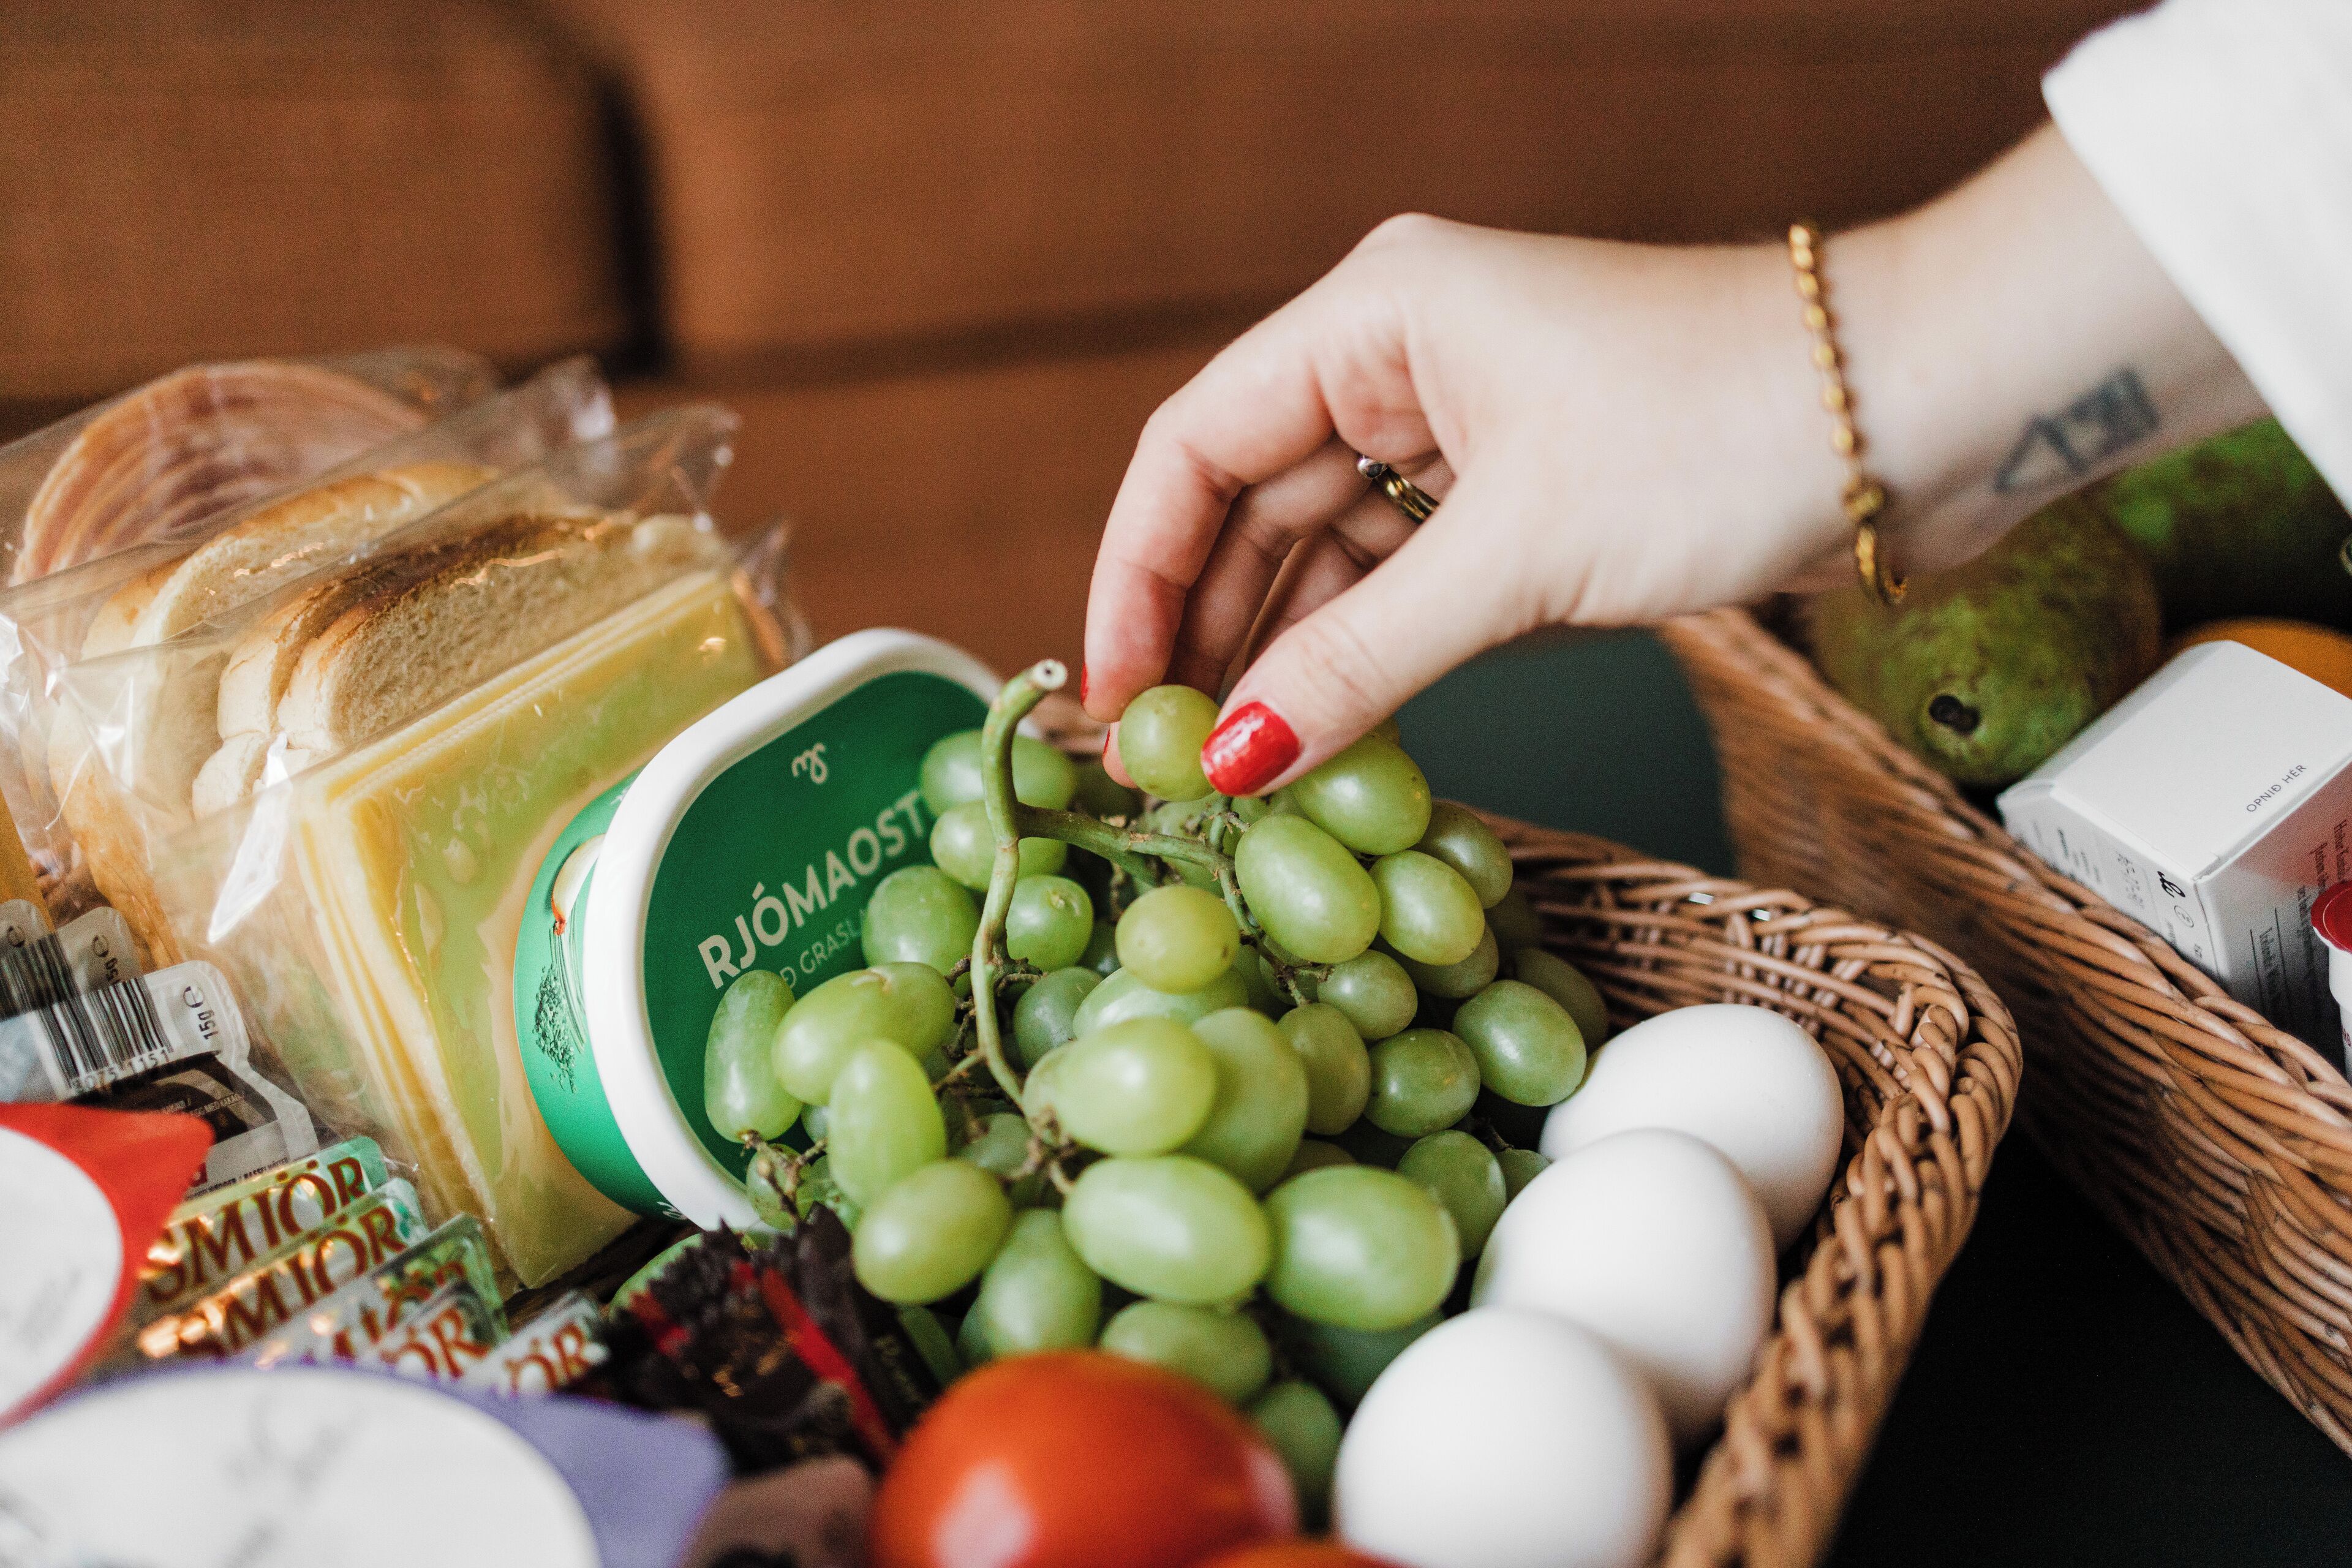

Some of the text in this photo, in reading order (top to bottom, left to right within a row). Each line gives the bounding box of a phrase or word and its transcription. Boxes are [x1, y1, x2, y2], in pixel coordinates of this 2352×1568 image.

[2246, 765, 2307, 812] OPNIÐ HÉR
[800, 909, 865, 974] GRASL
[198, 1009, 219, 1040] 15g
